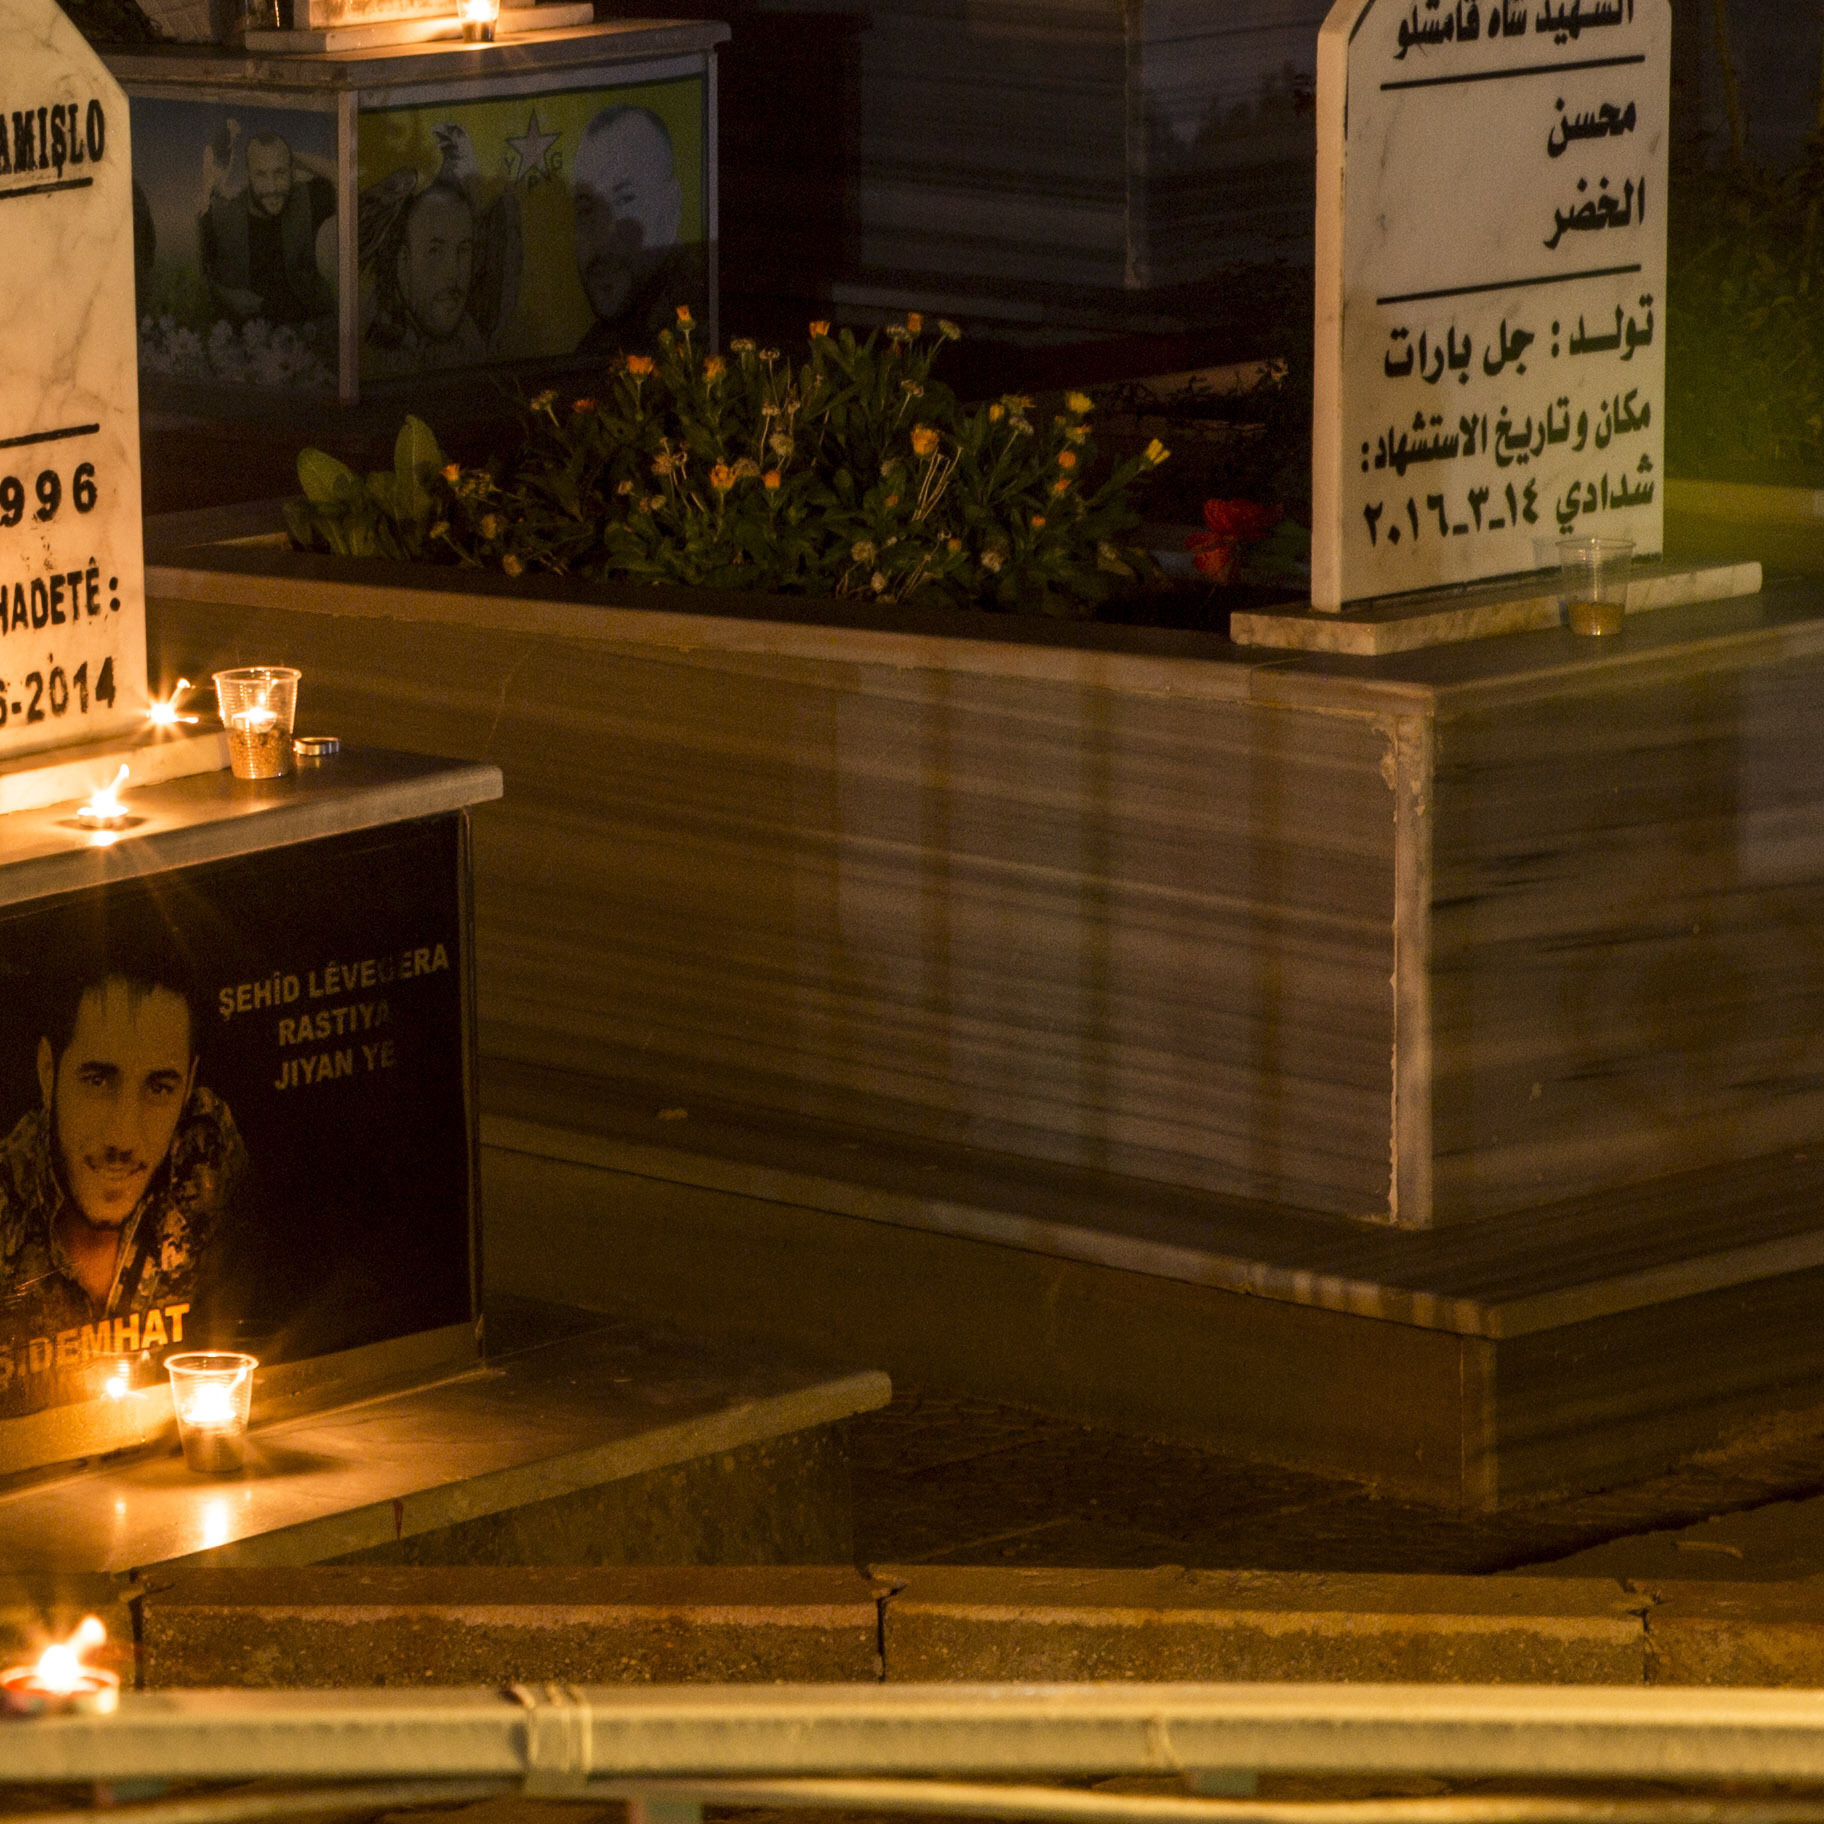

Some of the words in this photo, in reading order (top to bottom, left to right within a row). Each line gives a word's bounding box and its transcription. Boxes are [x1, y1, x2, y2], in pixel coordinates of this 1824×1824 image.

[1547, 96, 1636, 157] محسن
[1544, 176, 1644, 249] الخضر
[1595, 389, 1650, 450] مكان
[274, 1049, 353, 1091] JIYAN
